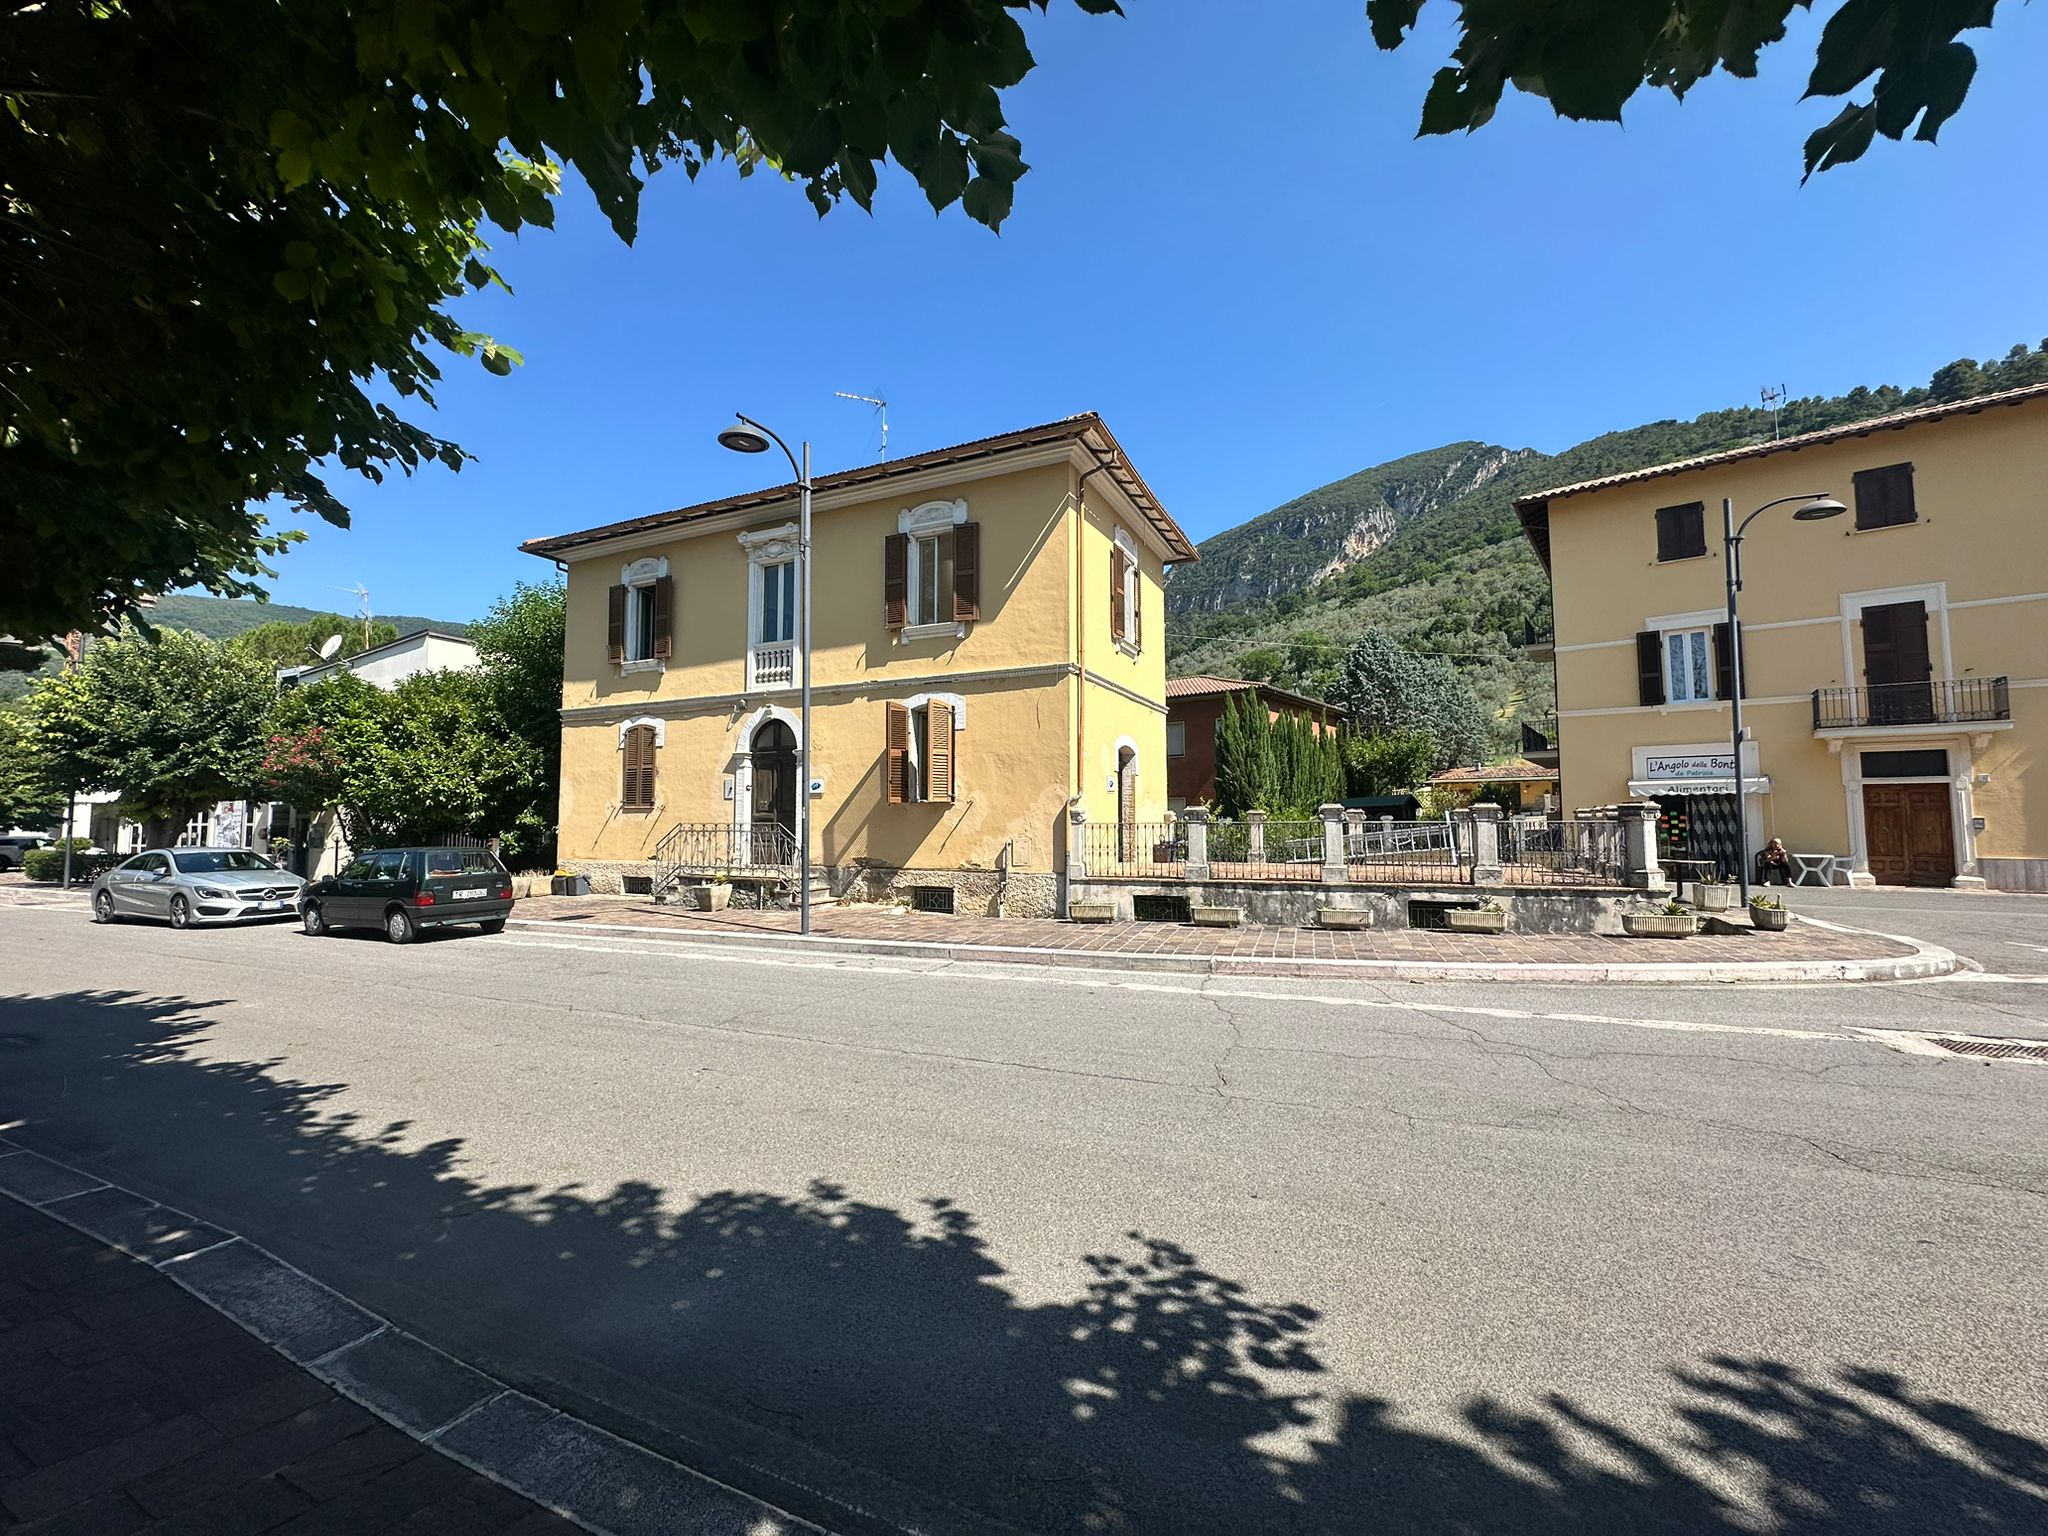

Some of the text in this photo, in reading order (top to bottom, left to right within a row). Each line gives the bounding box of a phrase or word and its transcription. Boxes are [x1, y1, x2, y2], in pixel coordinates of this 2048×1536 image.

[1650, 760, 1689, 773] L'Angolo
[1710, 758, 1736, 769] Bont
[1667, 784, 1729, 793] Alimentari
